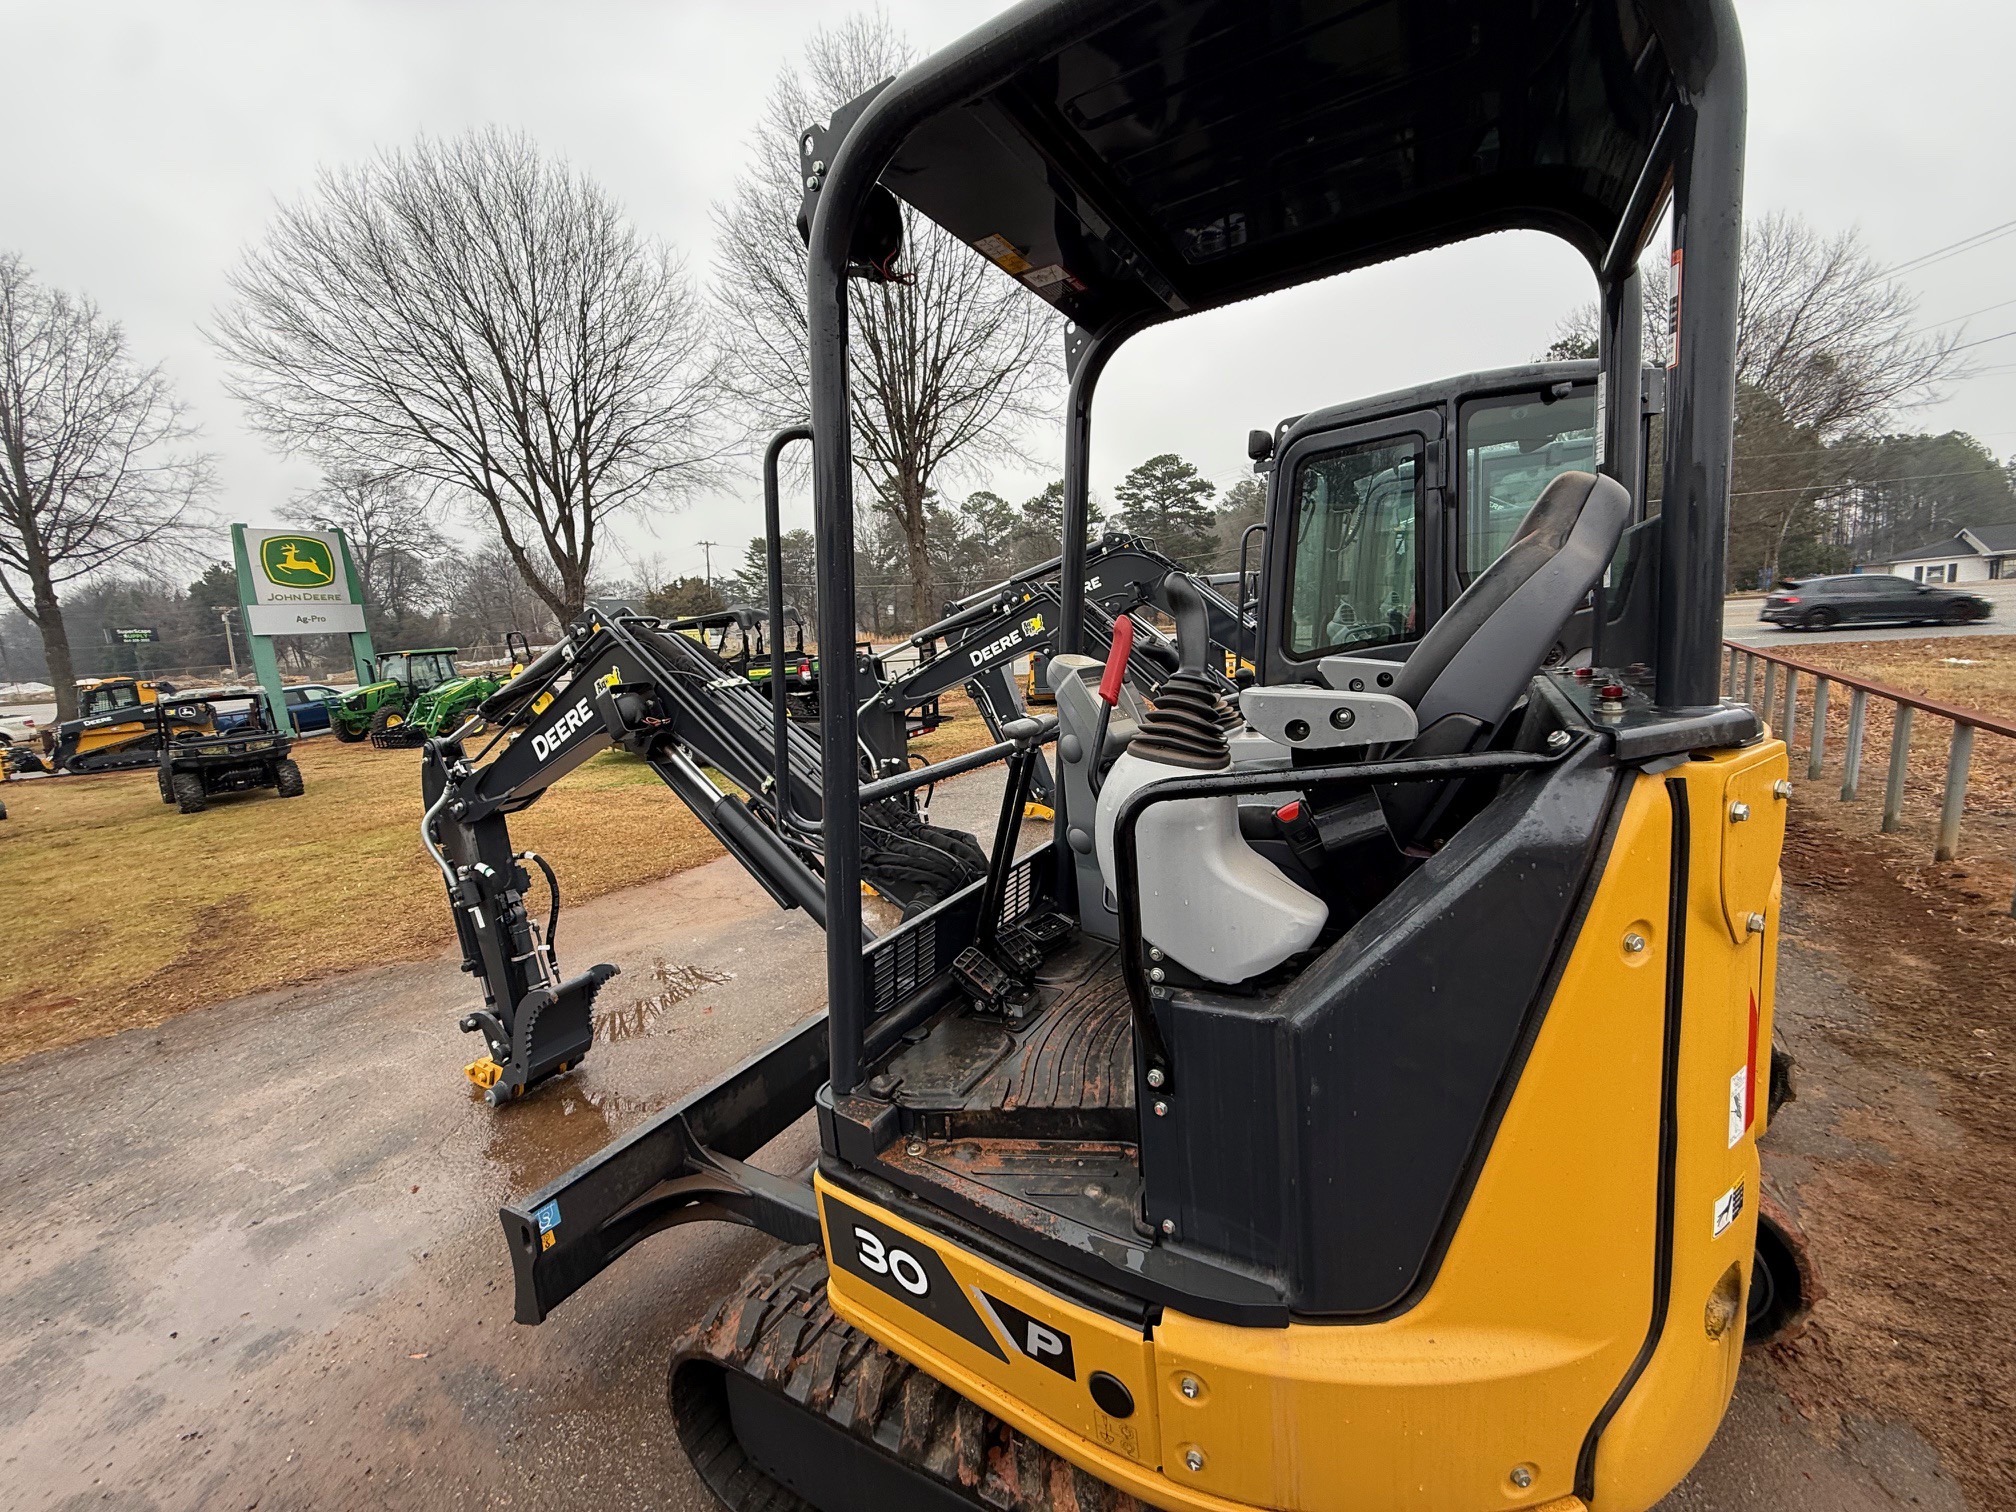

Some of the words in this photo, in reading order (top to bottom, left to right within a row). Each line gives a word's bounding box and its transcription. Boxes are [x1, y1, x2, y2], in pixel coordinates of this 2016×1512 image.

[267, 593, 301, 601] JOHN
[302, 592, 342, 601] DEERE
[296, 615, 326, 624] Ag-Pro
[969, 629, 1022, 667] DEERE
[83, 716, 113, 726] DEERE
[531, 697, 594, 762] DEERE
[855, 1226, 928, 1295] 30
[1026, 1320, 1063, 1357] P
